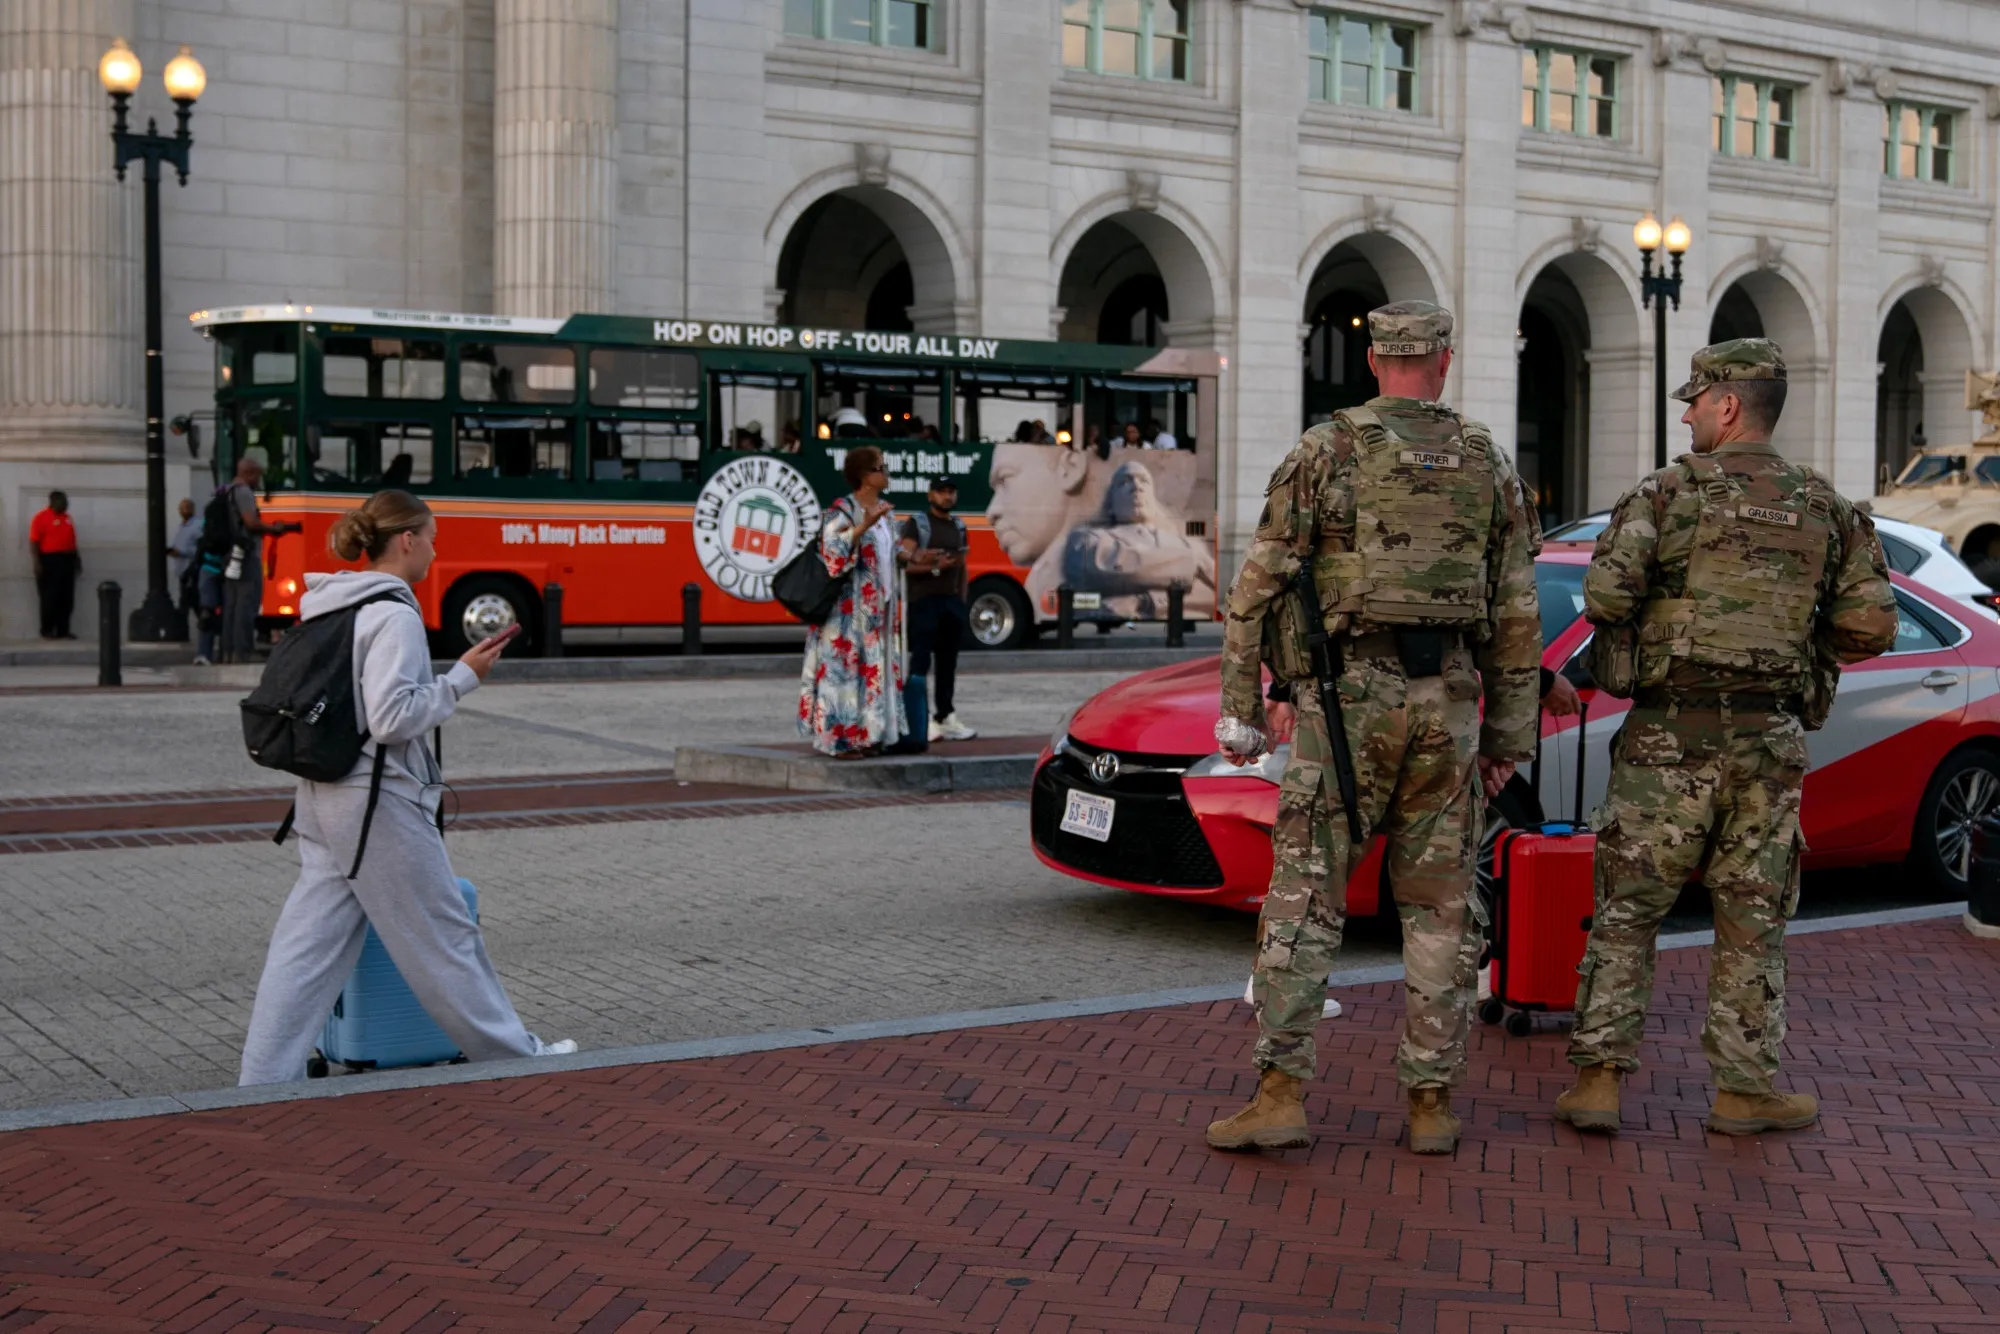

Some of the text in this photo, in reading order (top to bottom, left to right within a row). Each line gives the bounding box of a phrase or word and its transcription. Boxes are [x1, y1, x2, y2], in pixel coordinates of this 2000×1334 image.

[653, 320, 702, 342] HOP
[708, 323, 741, 345] ON
[747, 327, 794, 347] HOP
[915, 336, 954, 357] ALL
[958, 338, 999, 360] DAY
[1381, 343, 1416, 354] TURNER
[917, 450, 945, 474] Best
[1413, 453, 1449, 465] TURNER
[697, 460, 819, 548] OLD TOWN TROLLE
[1748, 507, 1789, 523] GRASSIA
[501, 523, 667, 547] 100% Money Back Guarantee
[705, 544, 776, 599] TOUR
[1086, 807, 1109, 830] 9706
